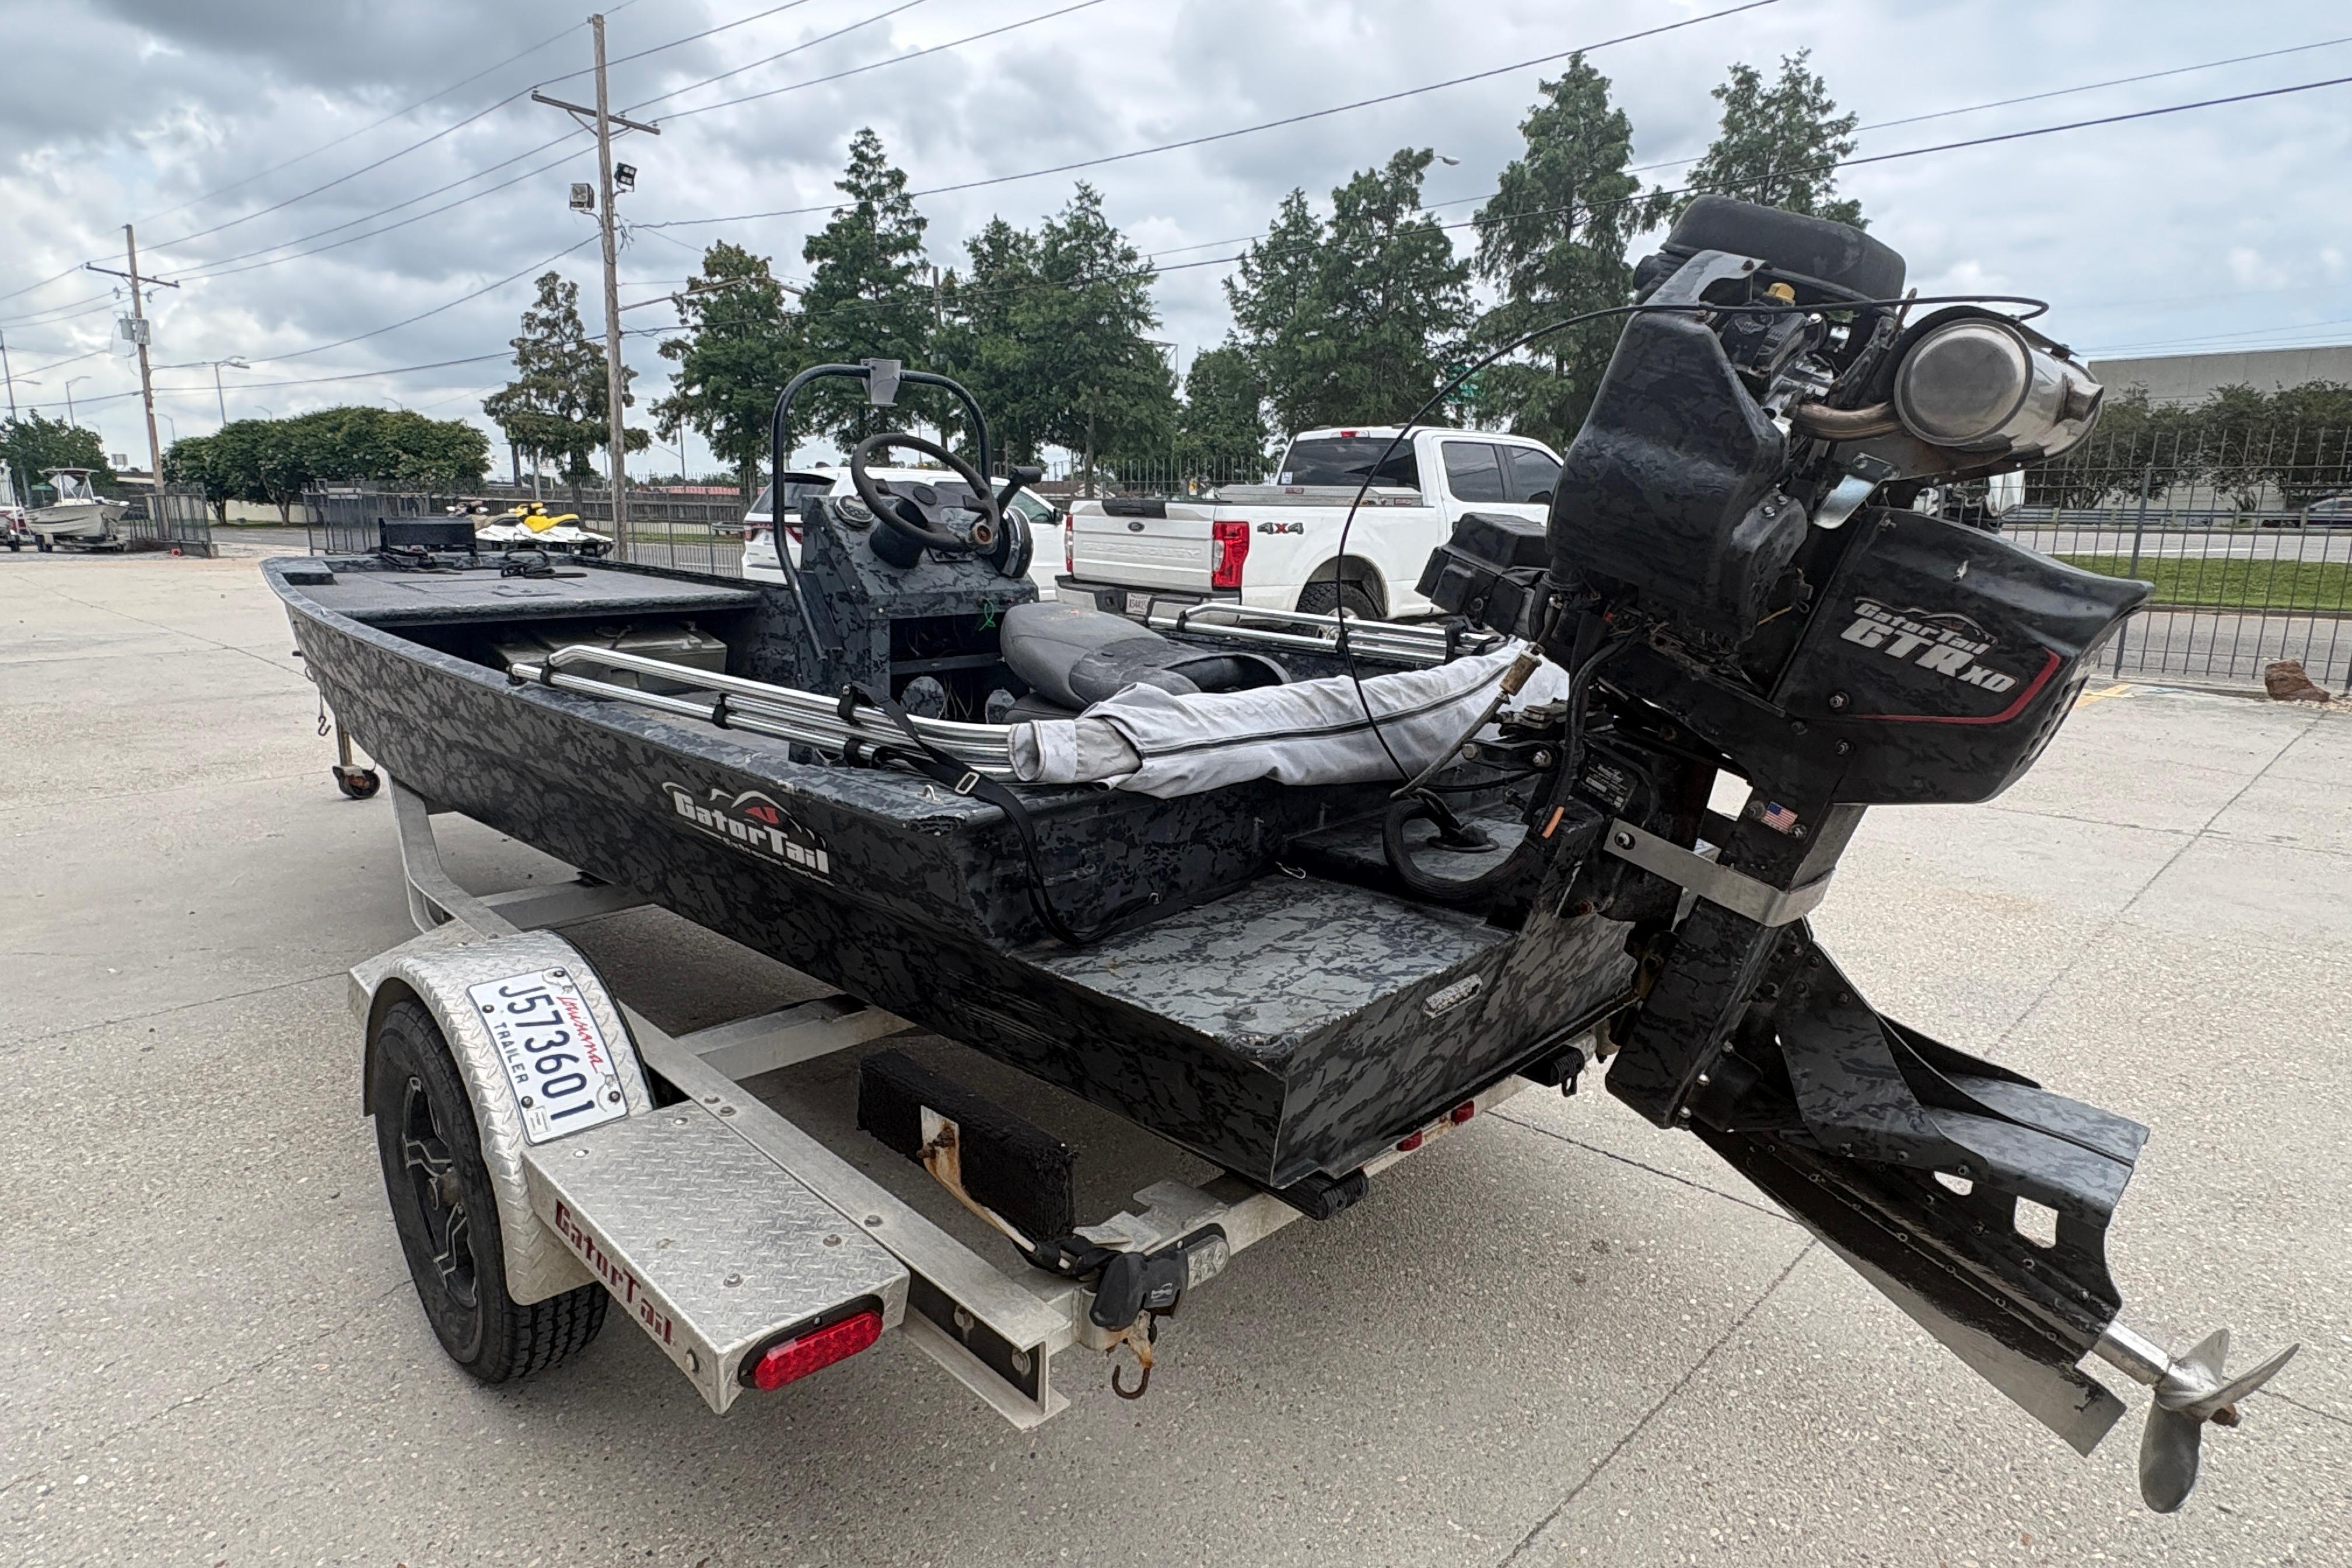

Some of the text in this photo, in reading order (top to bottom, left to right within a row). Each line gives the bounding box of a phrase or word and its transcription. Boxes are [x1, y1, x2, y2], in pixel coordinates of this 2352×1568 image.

[1840, 618, 2018, 694] GTR XD
[1854, 602, 1991, 656] GatorTail
[673, 791, 830, 875] GatorTail
[494, 1021, 529, 1084] TRAILER
[498, 986, 595, 1121] J573601
[555, 995, 605, 1074] Louisiana
[555, 1199, 673, 1346] GatorTail
